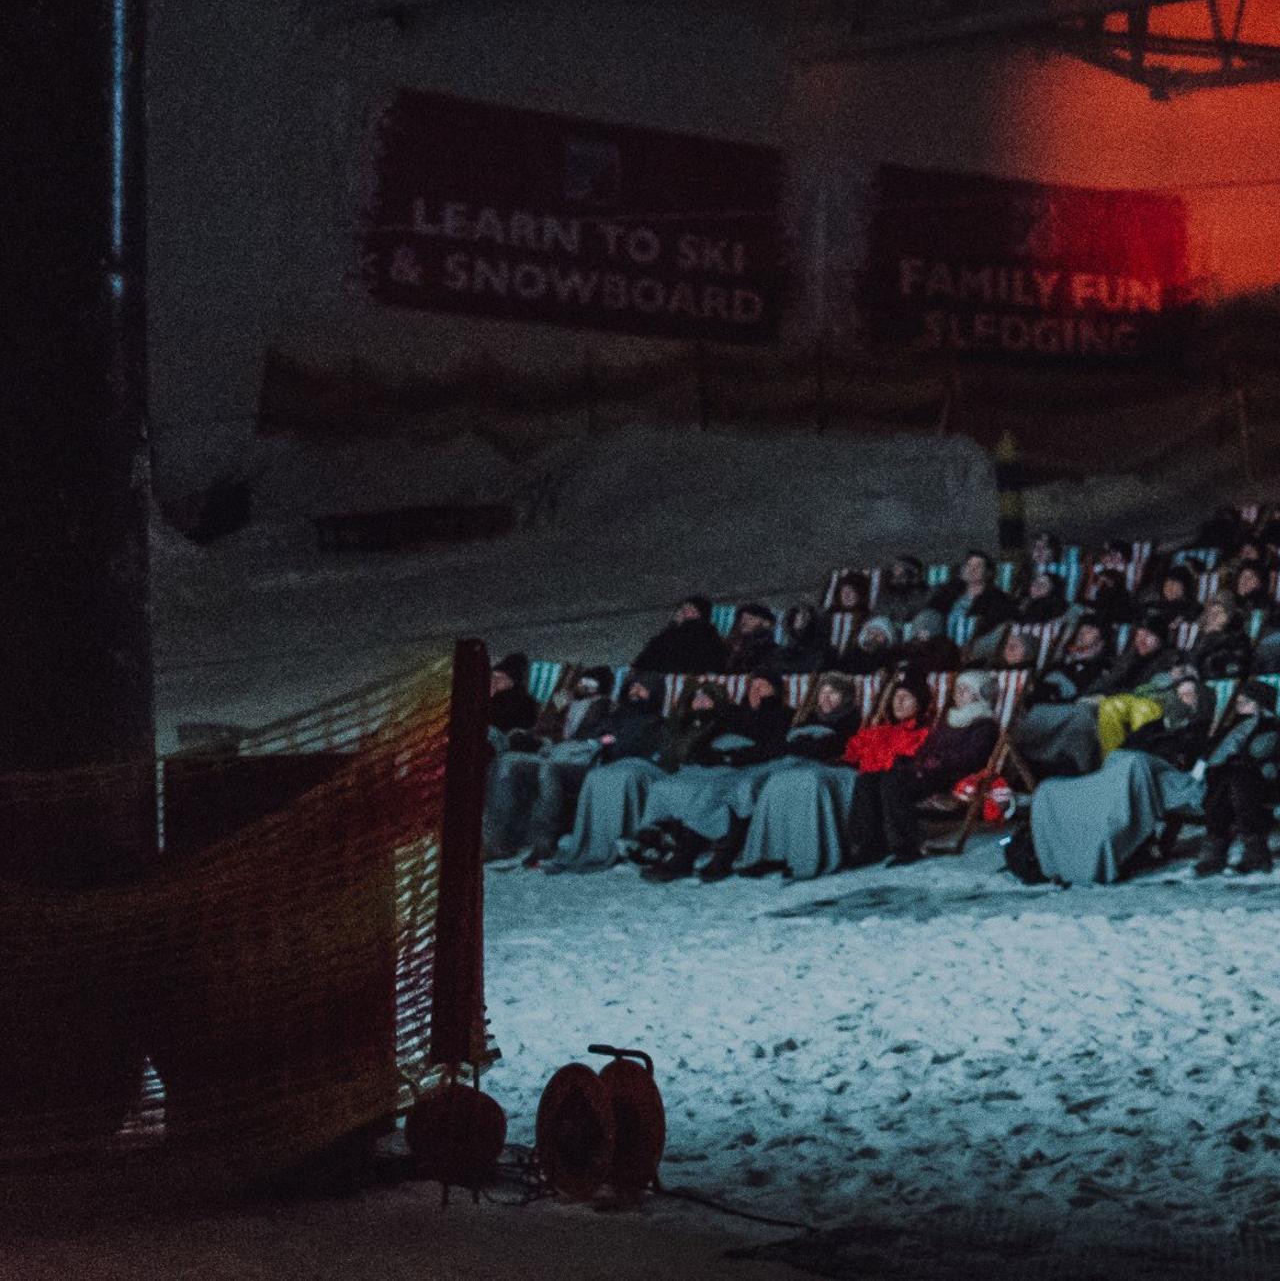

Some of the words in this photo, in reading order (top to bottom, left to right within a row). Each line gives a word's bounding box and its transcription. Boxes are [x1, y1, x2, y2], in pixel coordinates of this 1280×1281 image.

[411, 196, 581, 256] LEARN
[596, 222, 662, 265] TO
[676, 232, 748, 276] SKI
[388, 243, 423, 287] &
[443, 252, 764, 325] SNOWBOARD
[899, 256, 1062, 309] FAMILY
[1069, 269, 1163, 314] FUN
